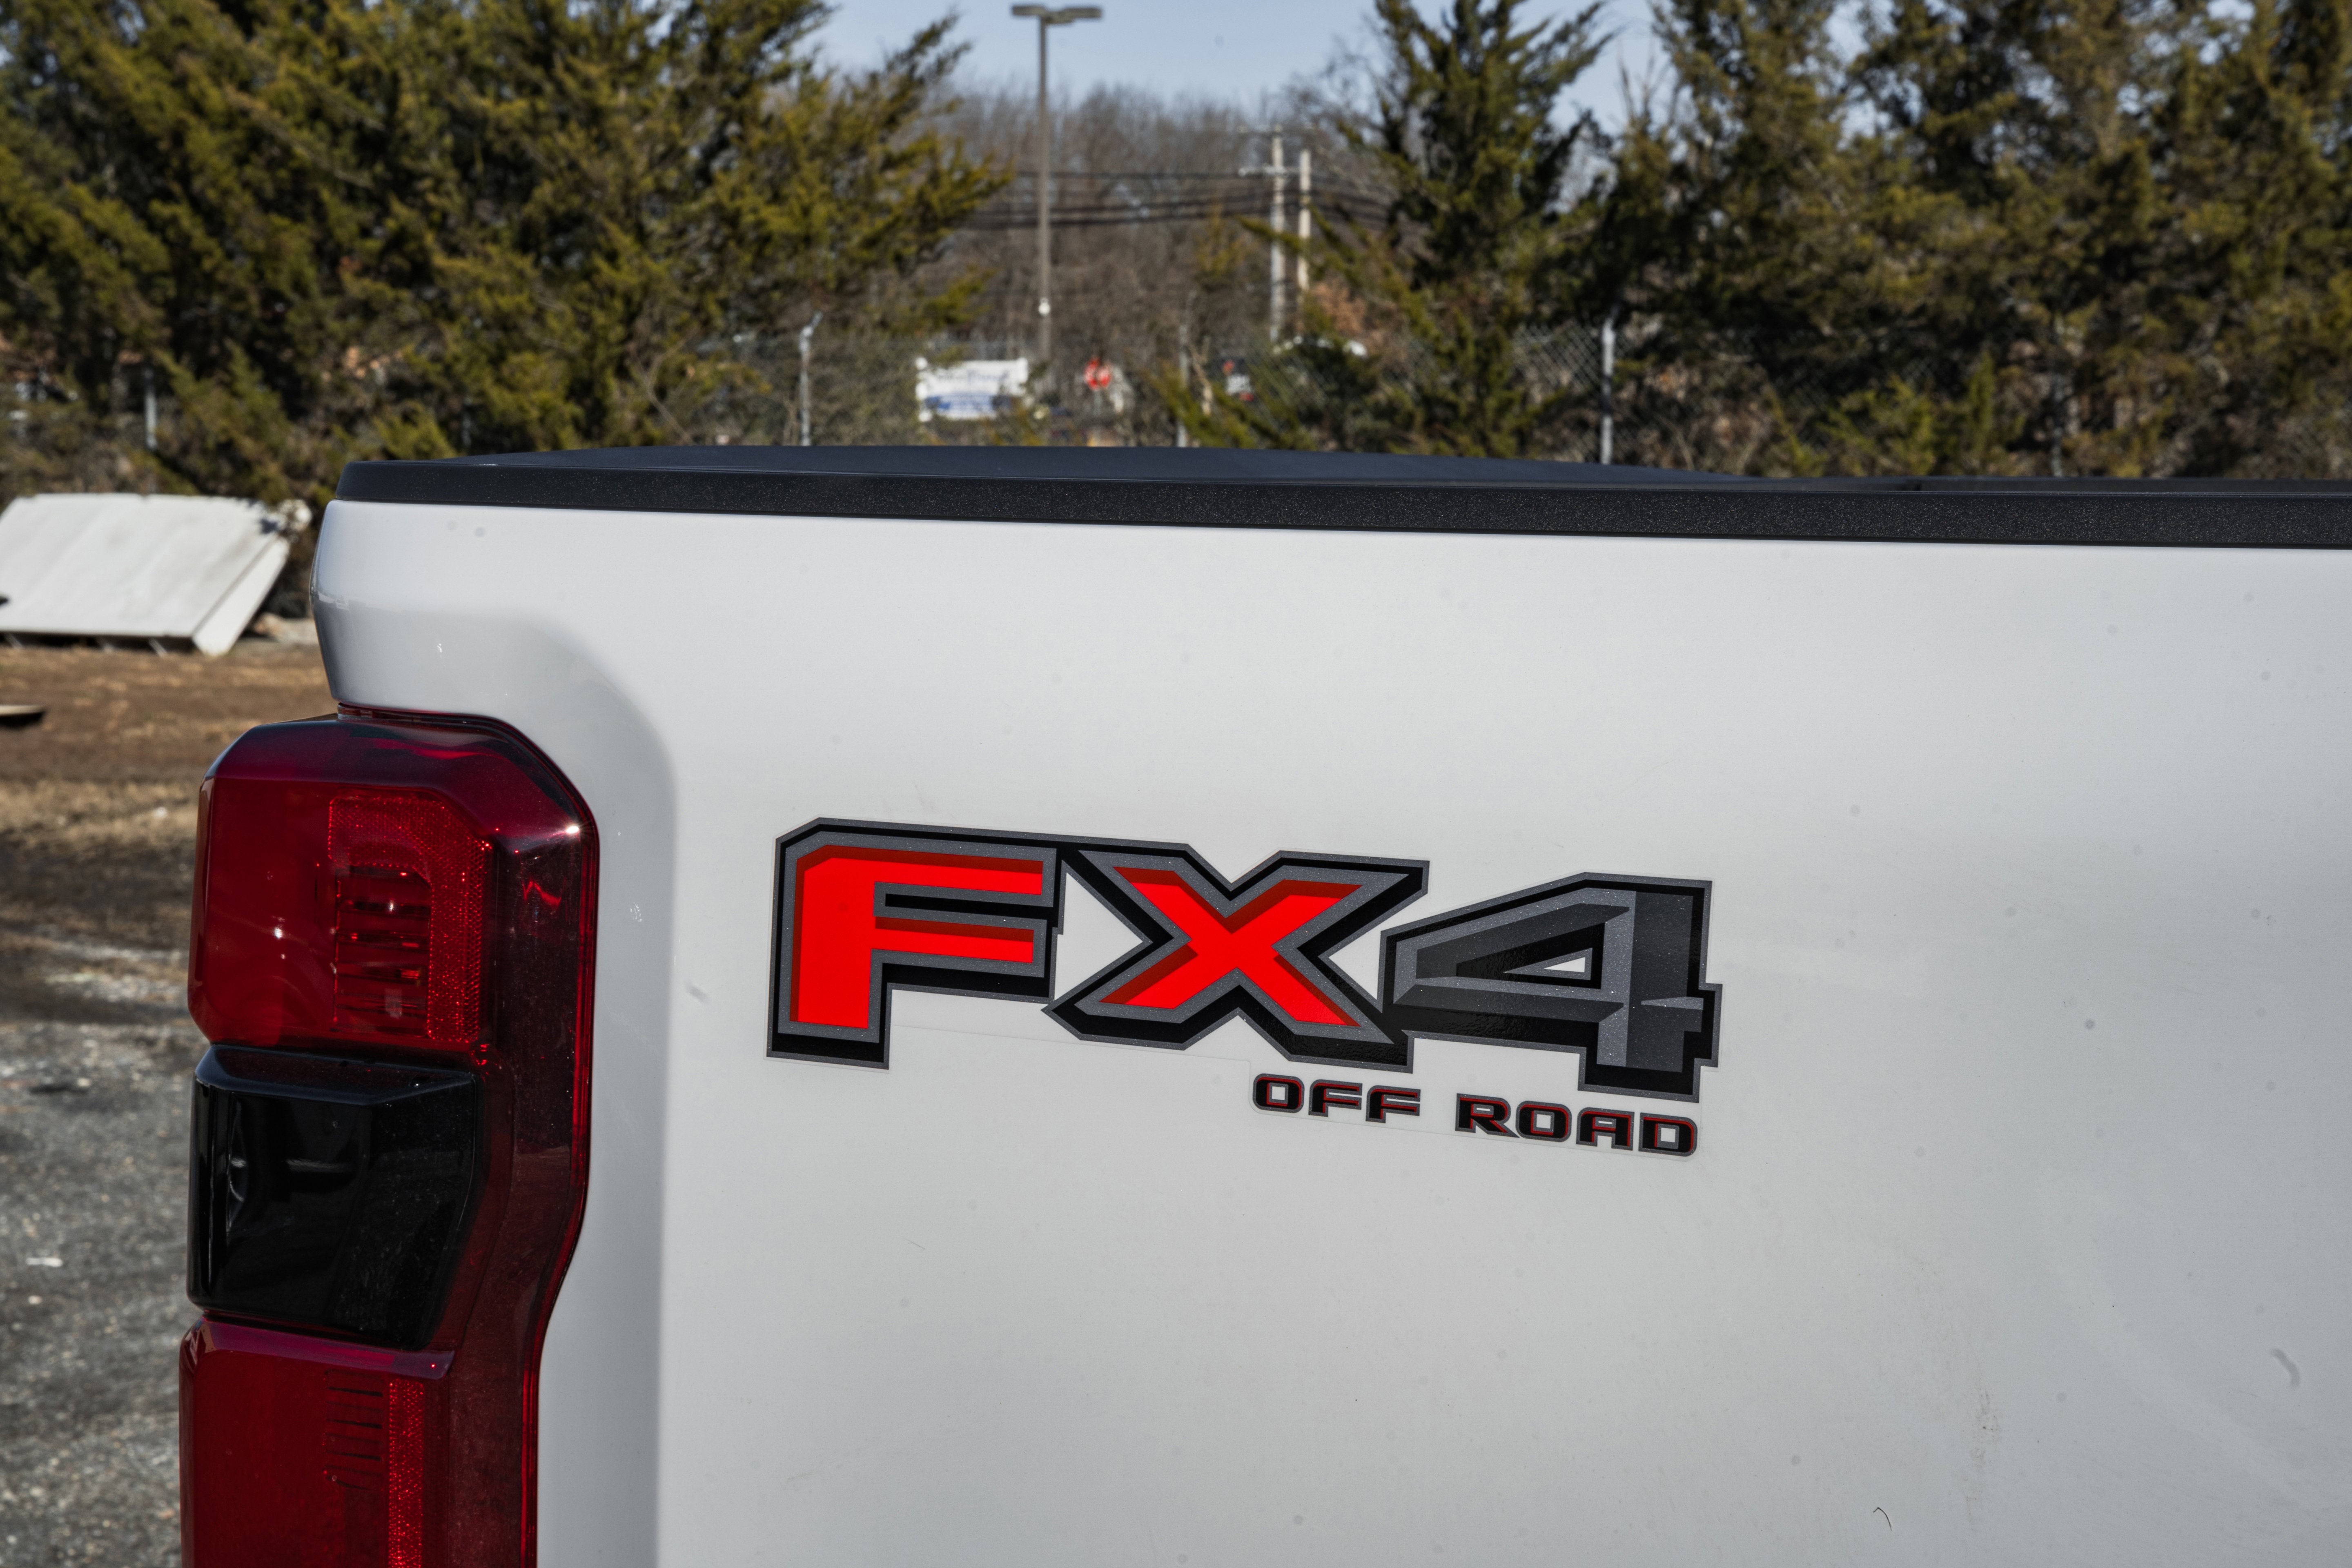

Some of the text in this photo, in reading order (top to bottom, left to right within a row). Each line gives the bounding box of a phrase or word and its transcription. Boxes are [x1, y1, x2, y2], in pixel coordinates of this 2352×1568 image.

[766, 817, 1723, 1103] FX4
[1252, 1074, 1698, 1157] OFF ROAD
